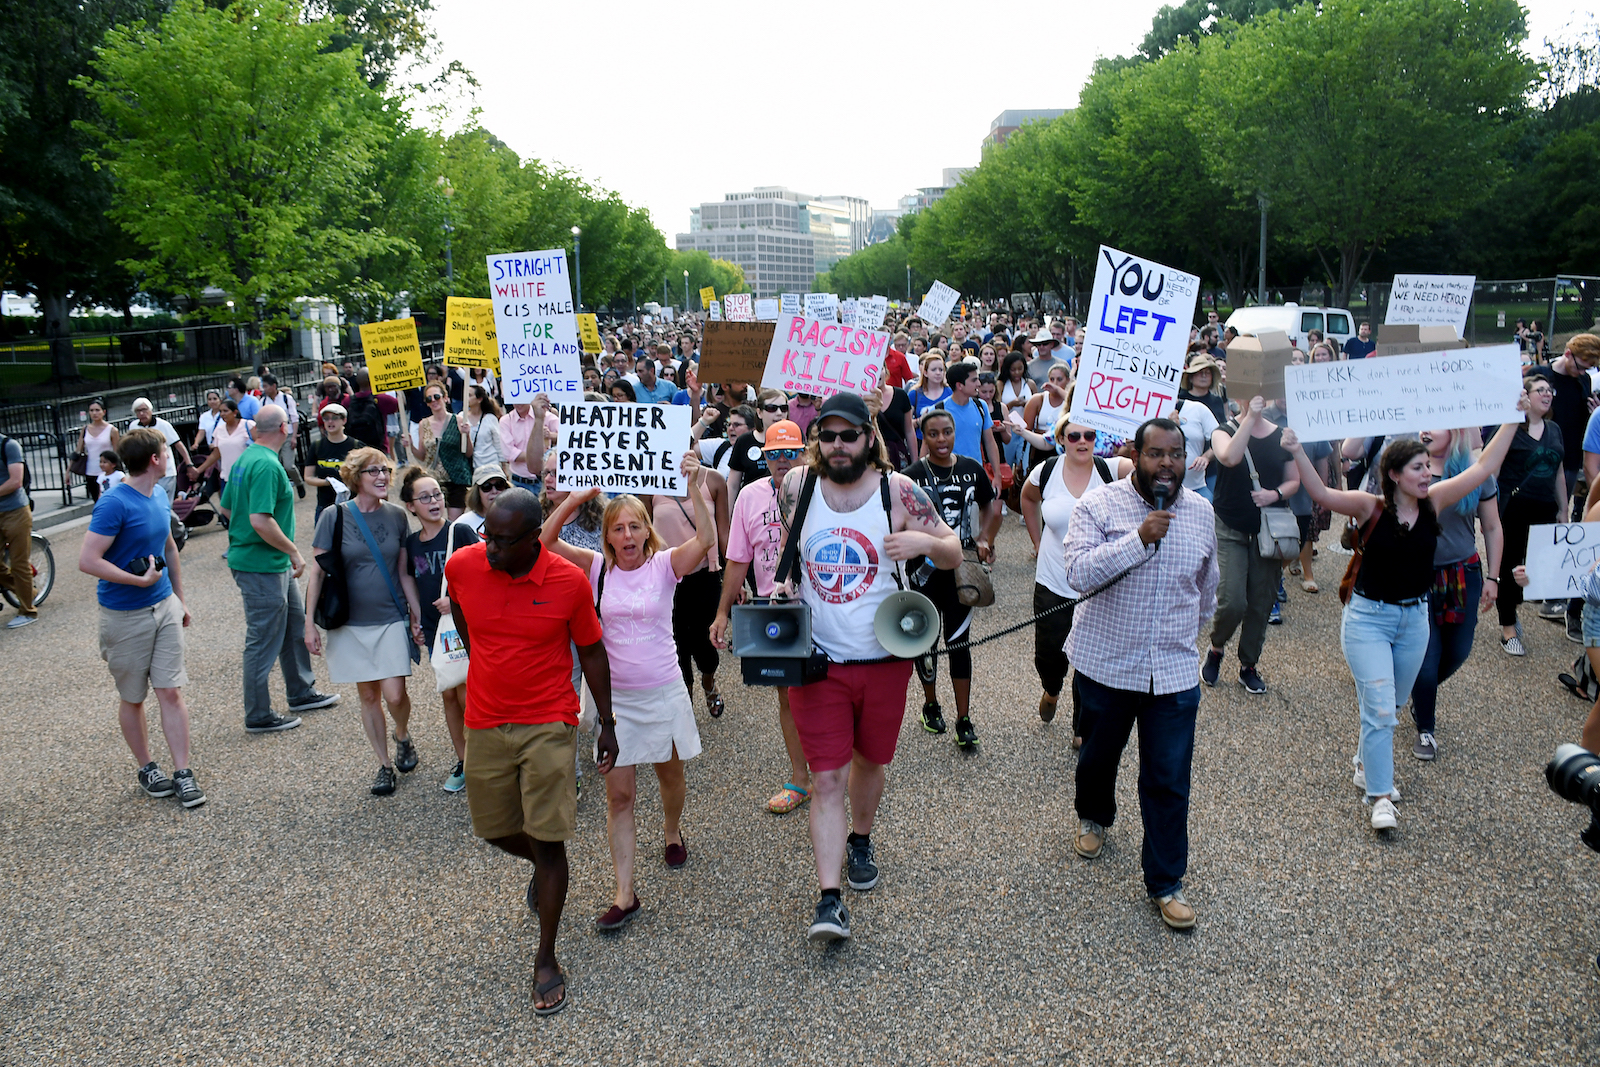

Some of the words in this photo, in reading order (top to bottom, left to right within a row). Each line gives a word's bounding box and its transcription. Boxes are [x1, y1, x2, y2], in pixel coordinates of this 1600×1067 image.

[493, 256, 563, 281] STRAIGHT
[1102, 249, 1165, 301] YOU
[1168, 270, 1197, 287] DON'T
[1397, 278, 1409, 288] We
[1413, 281, 1428, 290] don't
[495, 282, 546, 298] WHITE
[934, 281, 955, 298] WHITE
[1164, 289, 1175, 298] TO
[1166, 282, 1193, 297] NEED
[1394, 291, 1410, 300] WE
[1413, 291, 1439, 302] NEED
[504, 303, 530, 317] CIS
[538, 300, 572, 316] MALE
[726, 294, 750, 308] STOP
[923, 301, 944, 316] WHITE
[933, 298, 940, 306] IS
[1158, 296, 1170, 306] BE
[726, 306, 750, 314] HATE
[1099, 294, 1177, 341] LEFT
[377, 322, 414, 335] Charlottesville
[452, 321, 469, 331] Shut
[523, 322, 555, 339] FOR
[379, 335, 395, 343] White
[461, 336, 481, 346] white
[787, 316, 887, 358] RACISM
[371, 346, 391, 358] Shut
[392, 344, 415, 355] down
[501, 342, 547, 359] RACIAL
[553, 342, 577, 355] AND
[1115, 337, 1129, 351] TO
[1130, 344, 1164, 357] KNOW
[384, 359, 408, 370] white
[519, 363, 563, 376] SOCIAL
[780, 348, 879, 392] KILLS
[1091, 342, 1141, 373] THIS
[1142, 358, 1179, 383] ISN'T
[1291, 368, 1320, 383] THE
[1327, 366, 1360, 383] KKK
[1367, 366, 1389, 380] don't
[1397, 364, 1421, 376] need
[1430, 359, 1474, 374] HOODS
[374, 365, 422, 383] supremacy!
[510, 378, 578, 397] JUSTICE
[784, 380, 850, 397] CODEPI
[1085, 371, 1173, 419] RIGHT
[1295, 387, 1347, 402] PROTECT
[1401, 386, 1419, 398] they
[1425, 385, 1442, 393] have
[1453, 381, 1465, 391] the
[1439, 405, 1454, 413] that
[1472, 398, 1503, 411] them
[560, 405, 667, 430] HEATHER
[568, 430, 650, 451] HEYER
[559, 450, 675, 471] PRESENTE
[558, 473, 678, 490] #CHARLOTTESVILLE
[1554, 524, 1585, 545] DO
